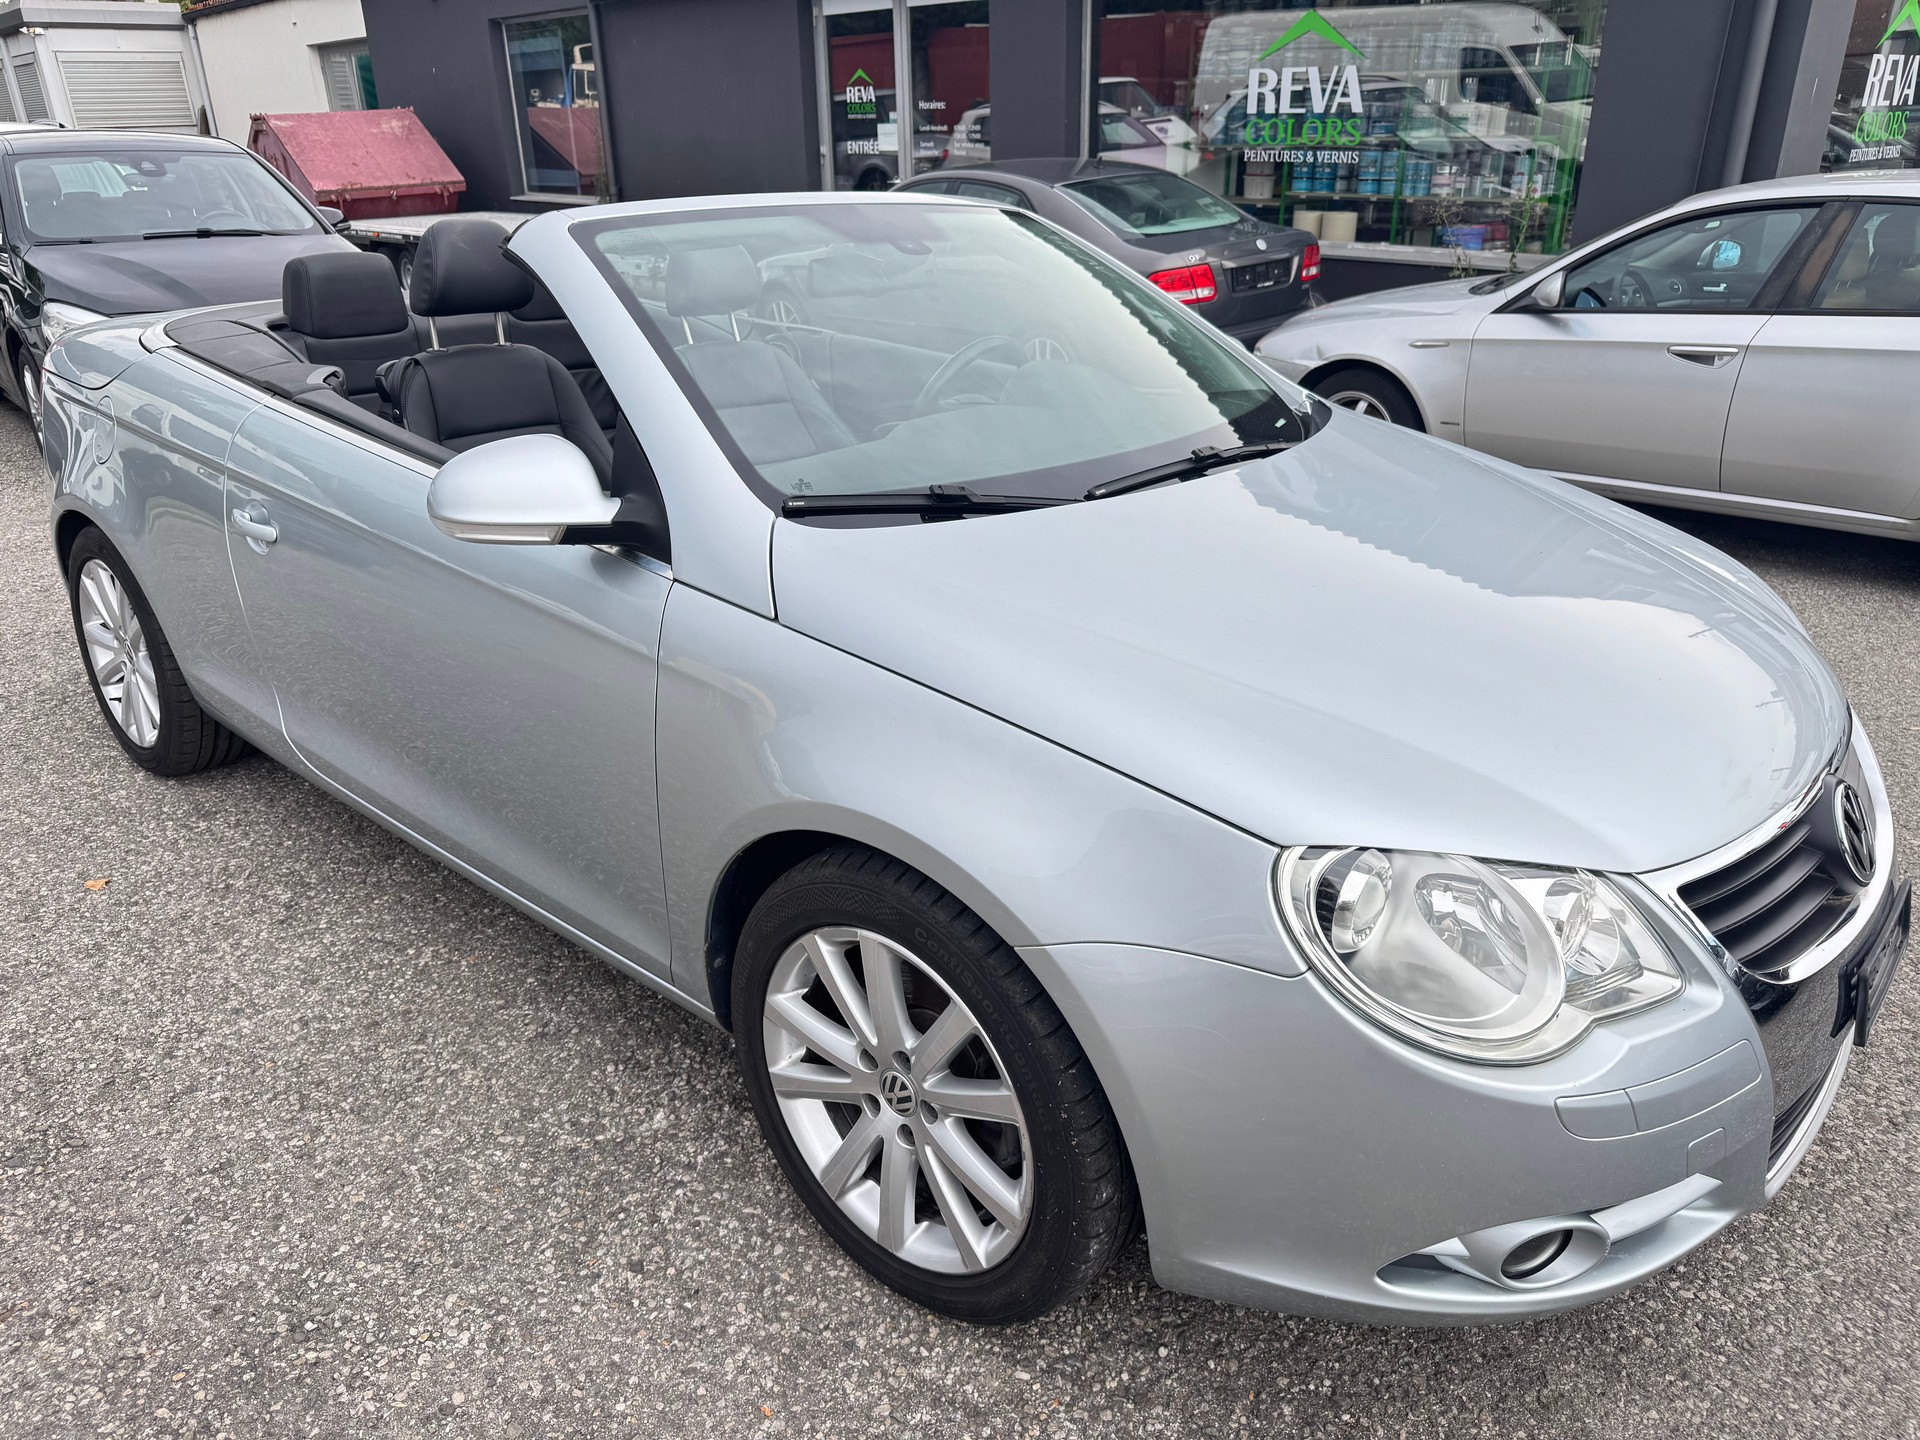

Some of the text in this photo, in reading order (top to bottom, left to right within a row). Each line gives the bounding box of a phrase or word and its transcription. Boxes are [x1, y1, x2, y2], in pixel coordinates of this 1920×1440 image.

[1861, 53, 1920, 107] REVA
[846, 85, 876, 103] REVA
[1246, 65, 1363, 115] REVA
[847, 103, 877, 114] COLORS
[1245, 117, 1362, 146] COLORS
[1854, 110, 1910, 144] COLORS
[847, 138, 880, 154] ENTRÉE
[1848, 146, 1878, 163] PEINTURES
[1243, 150, 1360, 164] PEINTURES & VERNIS
